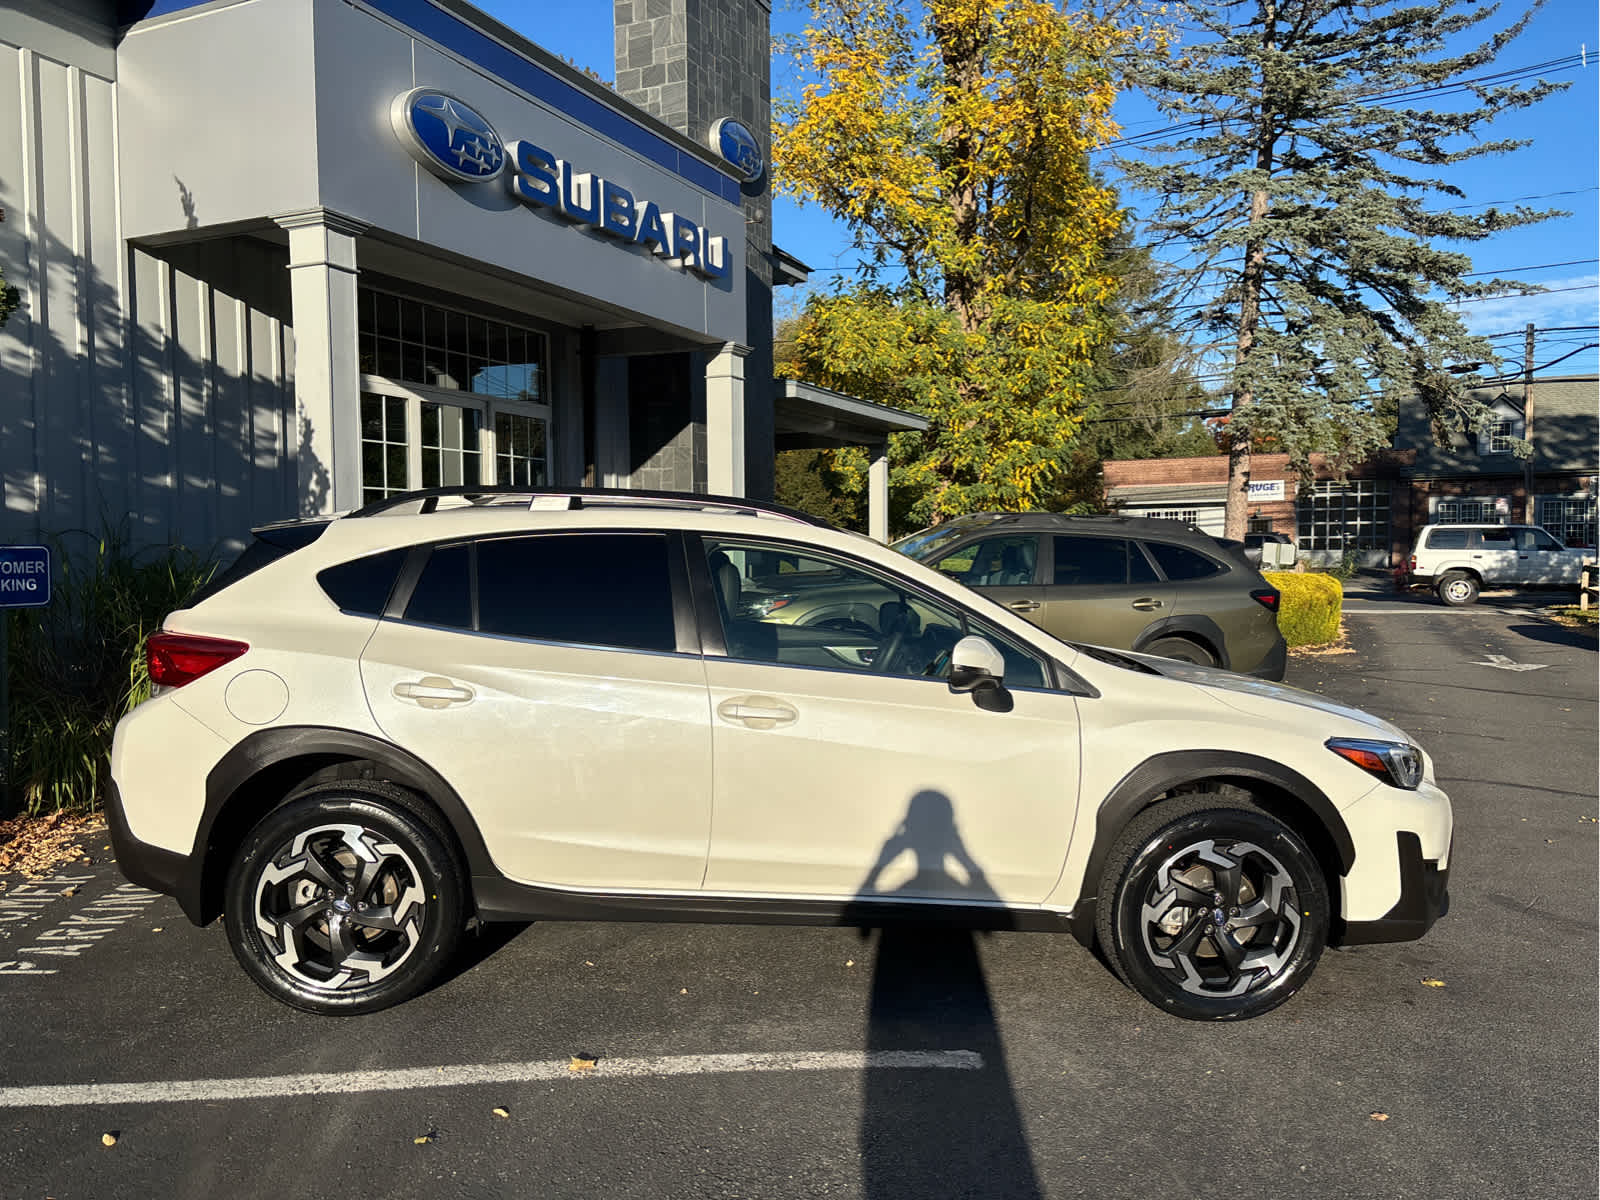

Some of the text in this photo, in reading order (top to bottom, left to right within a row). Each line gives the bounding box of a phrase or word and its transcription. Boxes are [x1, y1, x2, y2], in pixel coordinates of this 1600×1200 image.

[508, 140, 729, 278] SUBARU
[0, 561, 45, 574] OMER
[0, 578, 37, 592] KING
